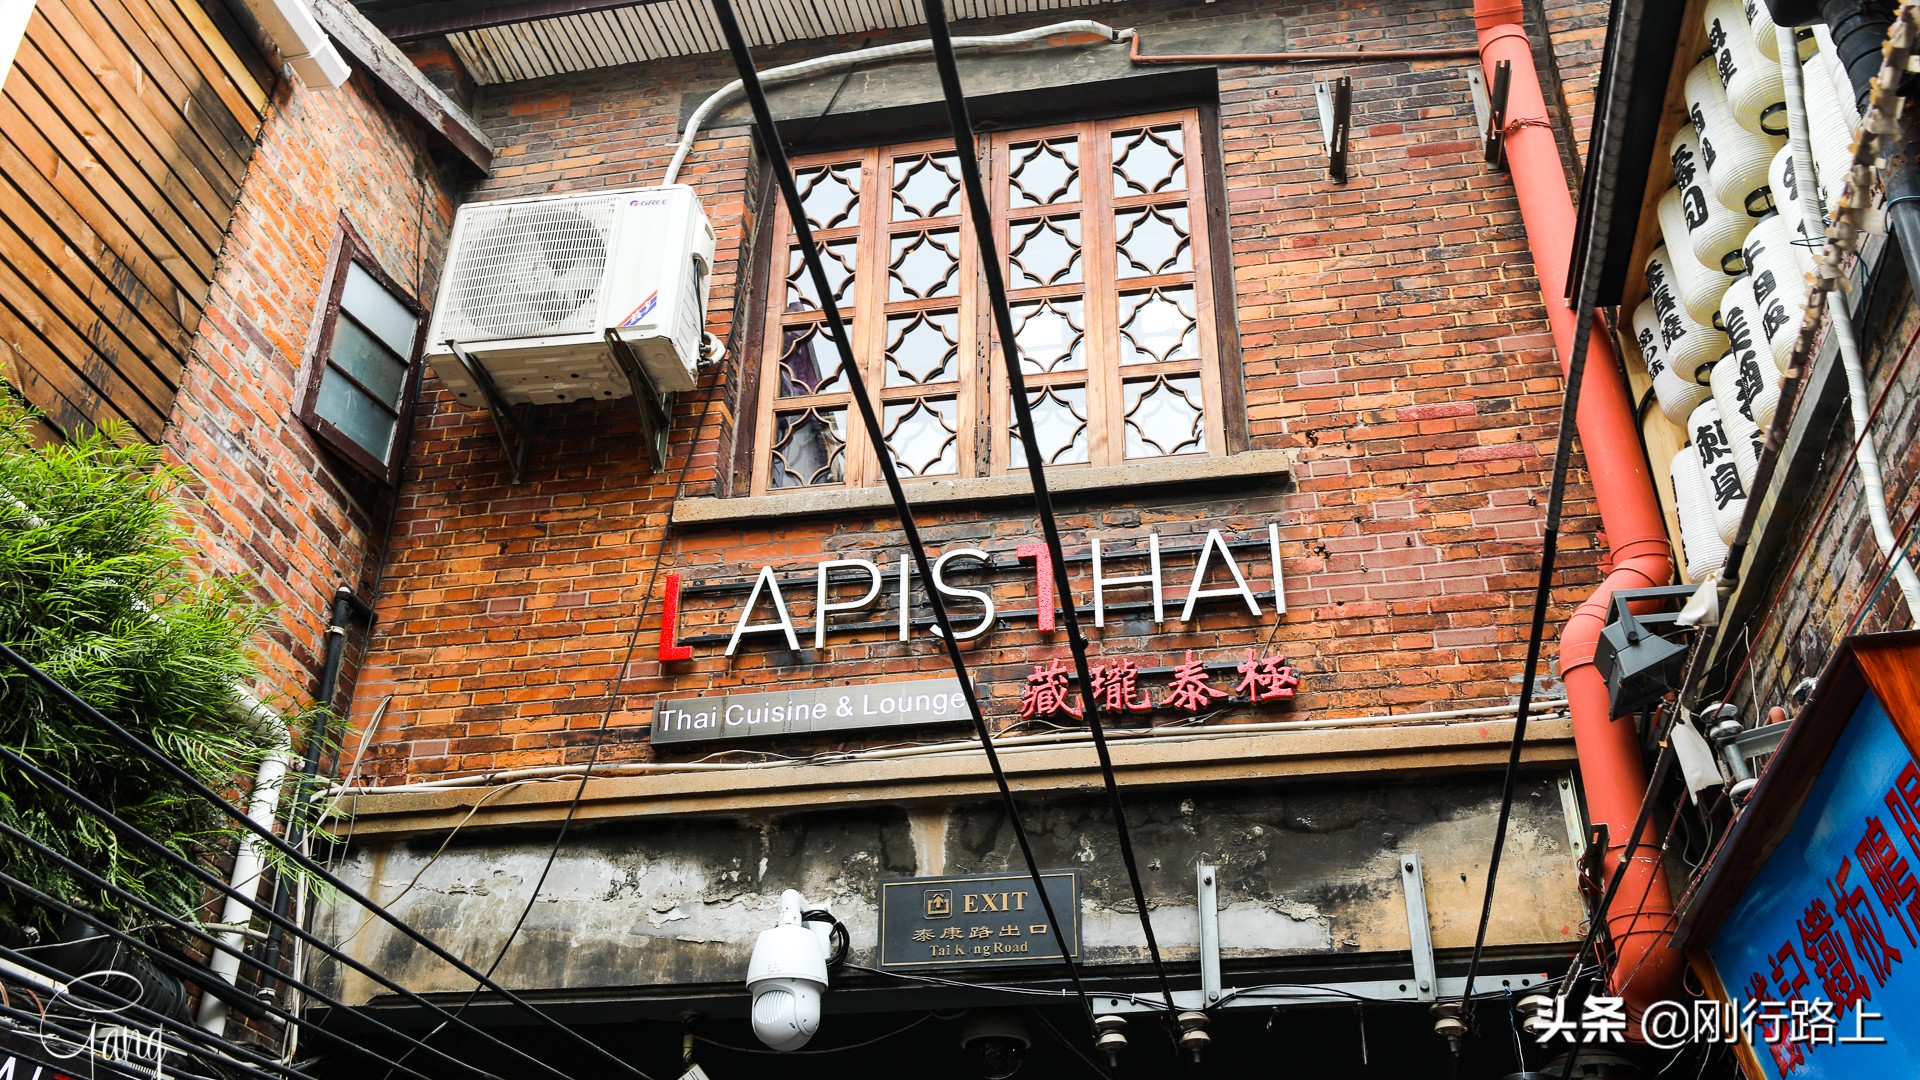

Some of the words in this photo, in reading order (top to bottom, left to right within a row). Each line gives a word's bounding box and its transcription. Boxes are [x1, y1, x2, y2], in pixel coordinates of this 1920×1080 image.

[1696, 418, 1747, 510] 刺身
[659, 707, 717, 732] Thai
[725, 702, 828, 726] Cuisine
[835, 695, 854, 718] &
[863, 691, 968, 715] Lounge
[963, 891, 1028, 913] EXIT
[911, 924, 1048, 942] 泰康路出口
[929, 943, 950, 958] Tai
[954, 943, 991, 957] Kng
[993, 941, 1029, 955] Road
